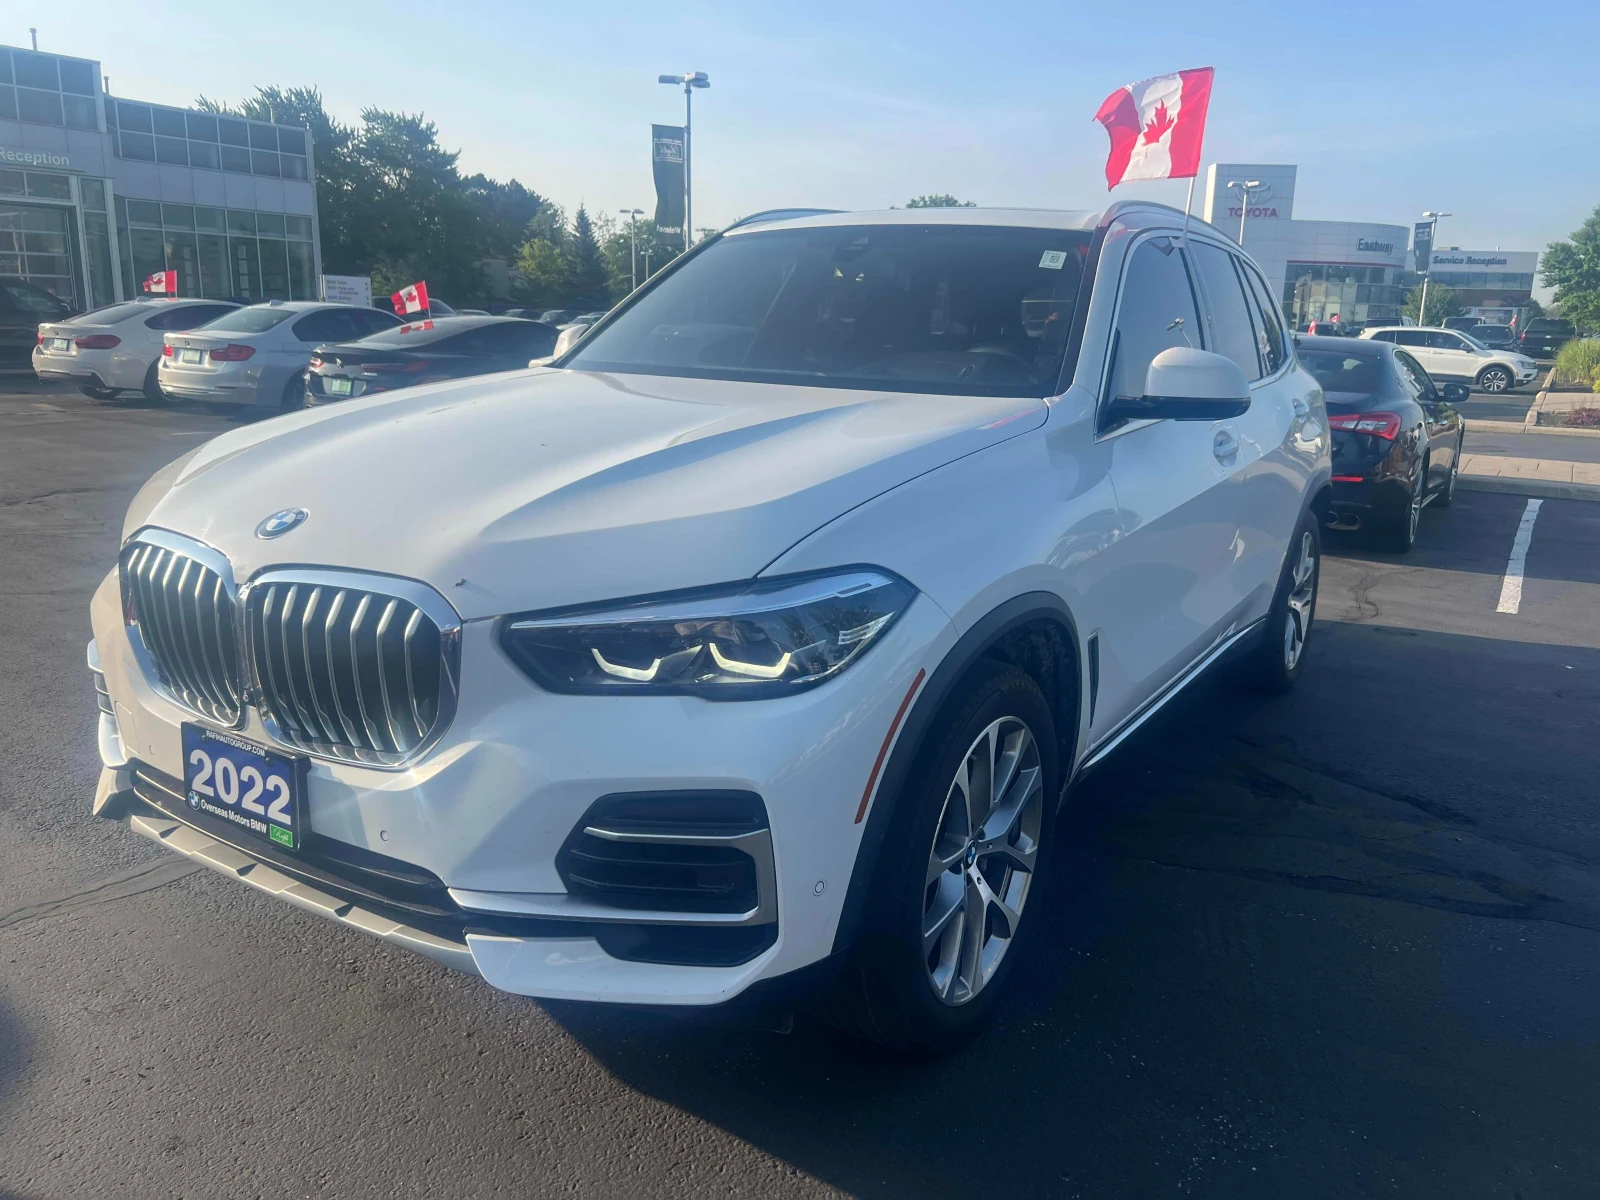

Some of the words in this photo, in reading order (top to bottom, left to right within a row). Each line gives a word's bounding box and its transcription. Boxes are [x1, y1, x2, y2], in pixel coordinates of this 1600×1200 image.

[0, 146, 70, 166] Reception
[1227, 206, 1278, 218] TOYOTA
[1357, 237, 1394, 255] Eastway
[1432, 255, 1465, 265] Service
[1465, 256, 1508, 267] Reception
[206, 729, 266, 757] RAFIHAUTOGROUP.COM
[190, 749, 292, 825] 2022
[200, 798, 228, 819] Overseas
[228, 809, 250, 828] Motors
[250, 818, 267, 834] BMW
